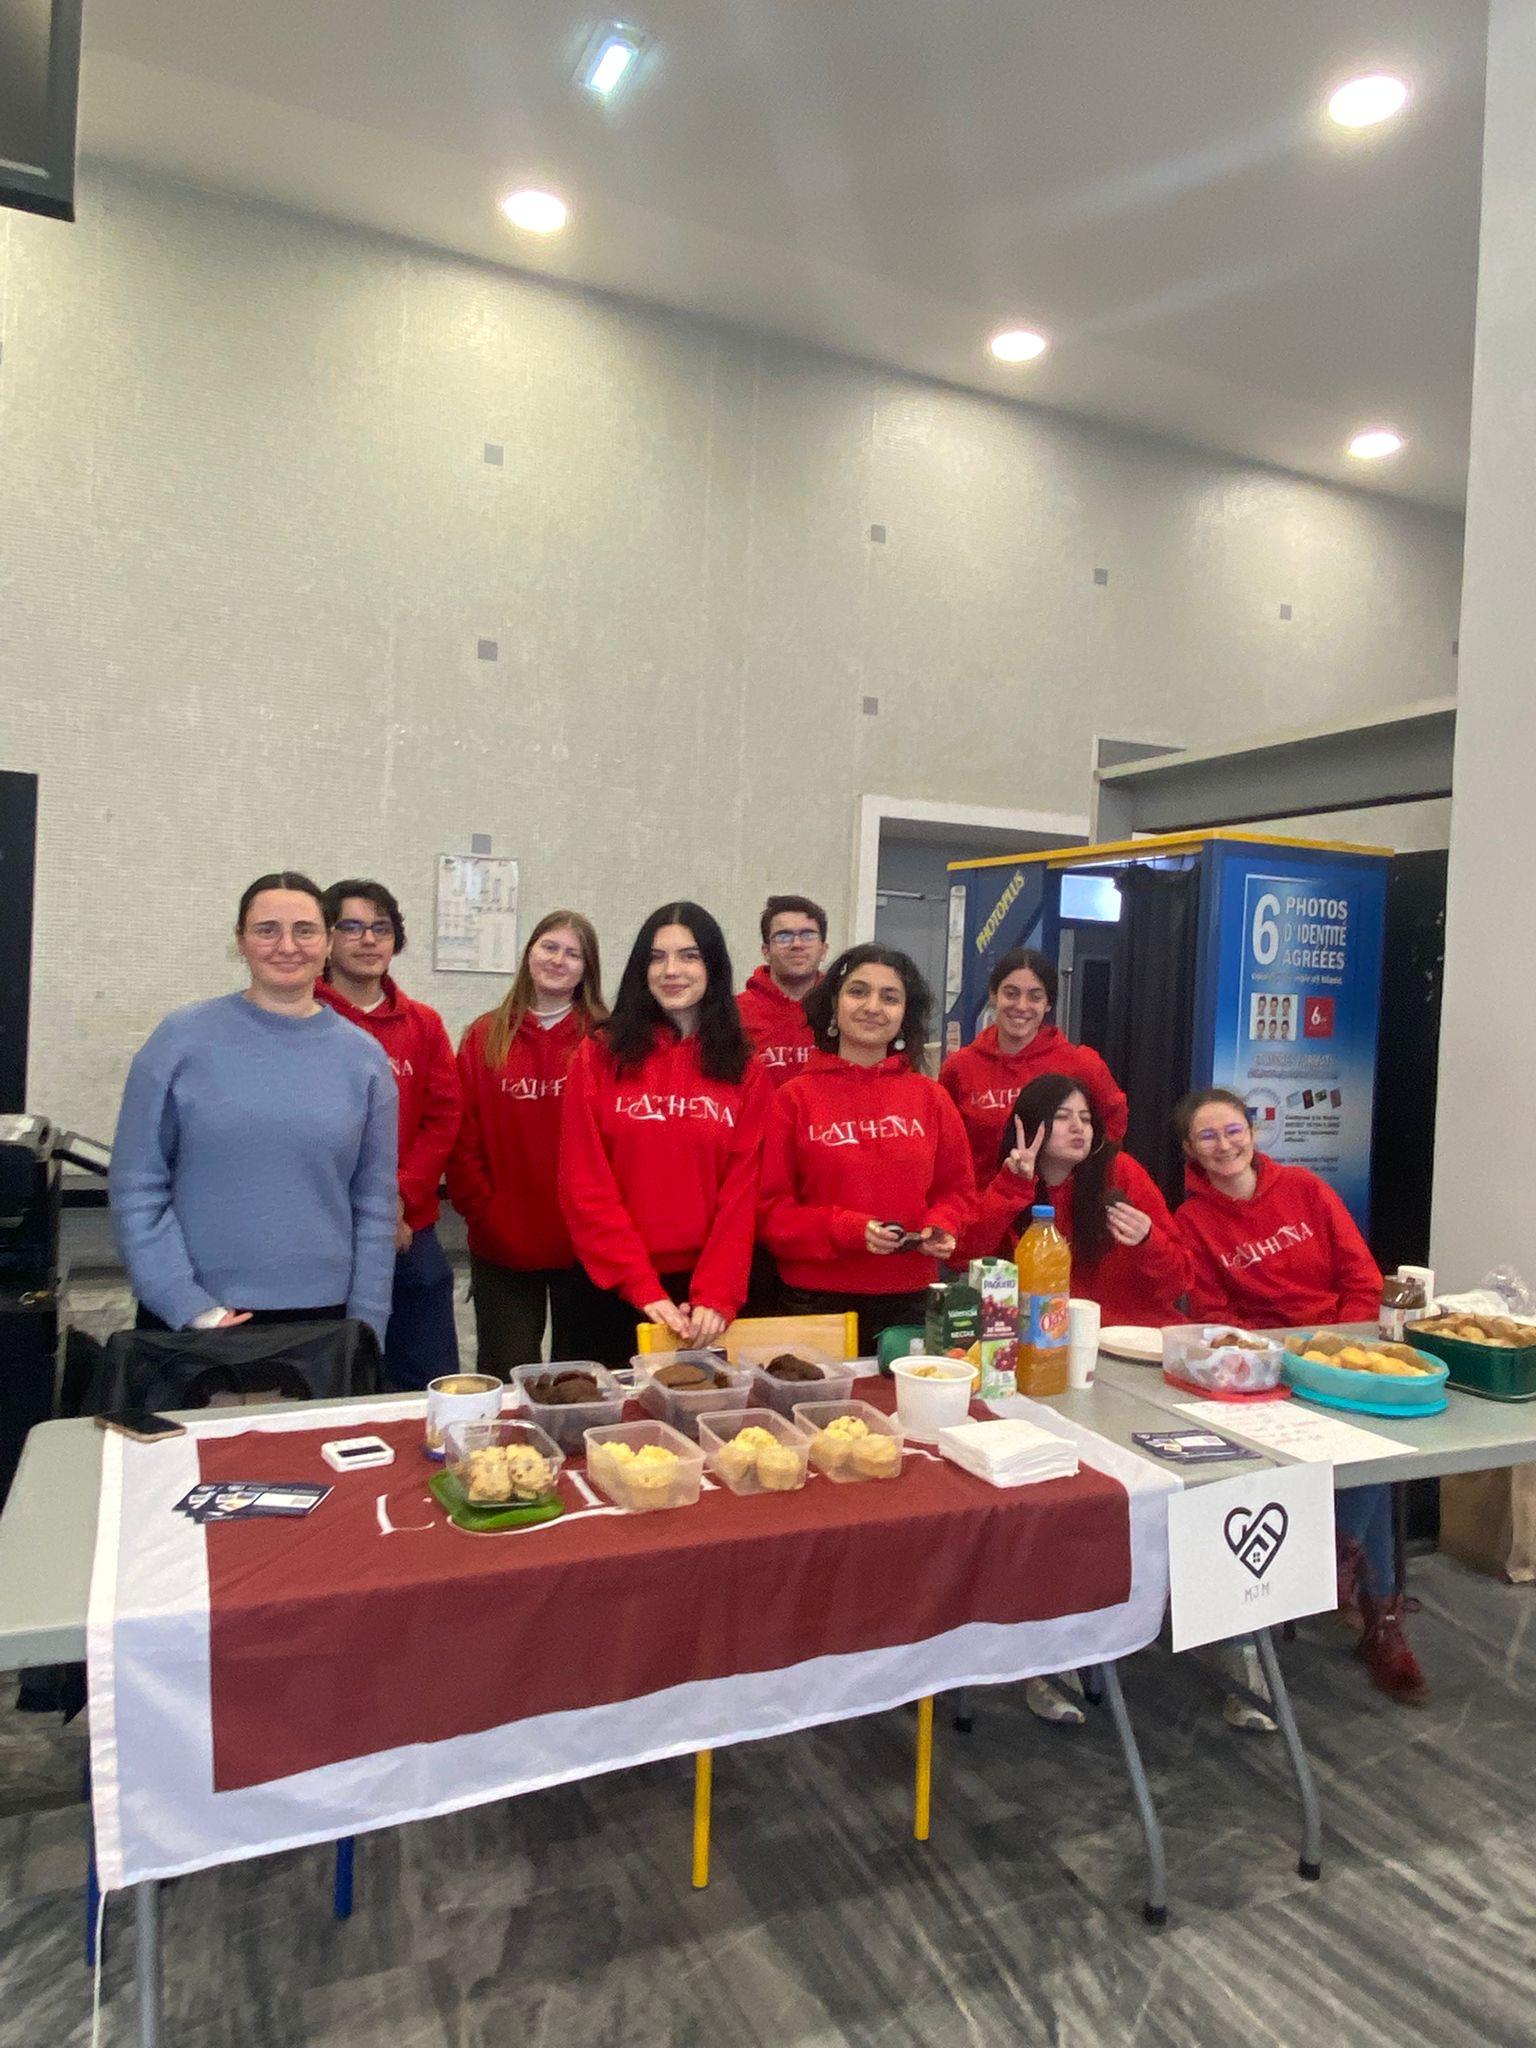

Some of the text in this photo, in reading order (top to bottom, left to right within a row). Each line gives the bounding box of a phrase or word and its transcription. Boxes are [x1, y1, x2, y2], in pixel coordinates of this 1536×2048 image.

[976, 869, 1025, 954] PHOTOPLUS
[1252, 893, 1349, 965] 6 PHOTOS
[1281, 944, 1346, 970] AGRÉÉES
[1310, 1005, 1321, 1026] 6
[615, 1093, 735, 1128] L'ATHENA
[808, 1115, 926, 1147] L'ATHENA
